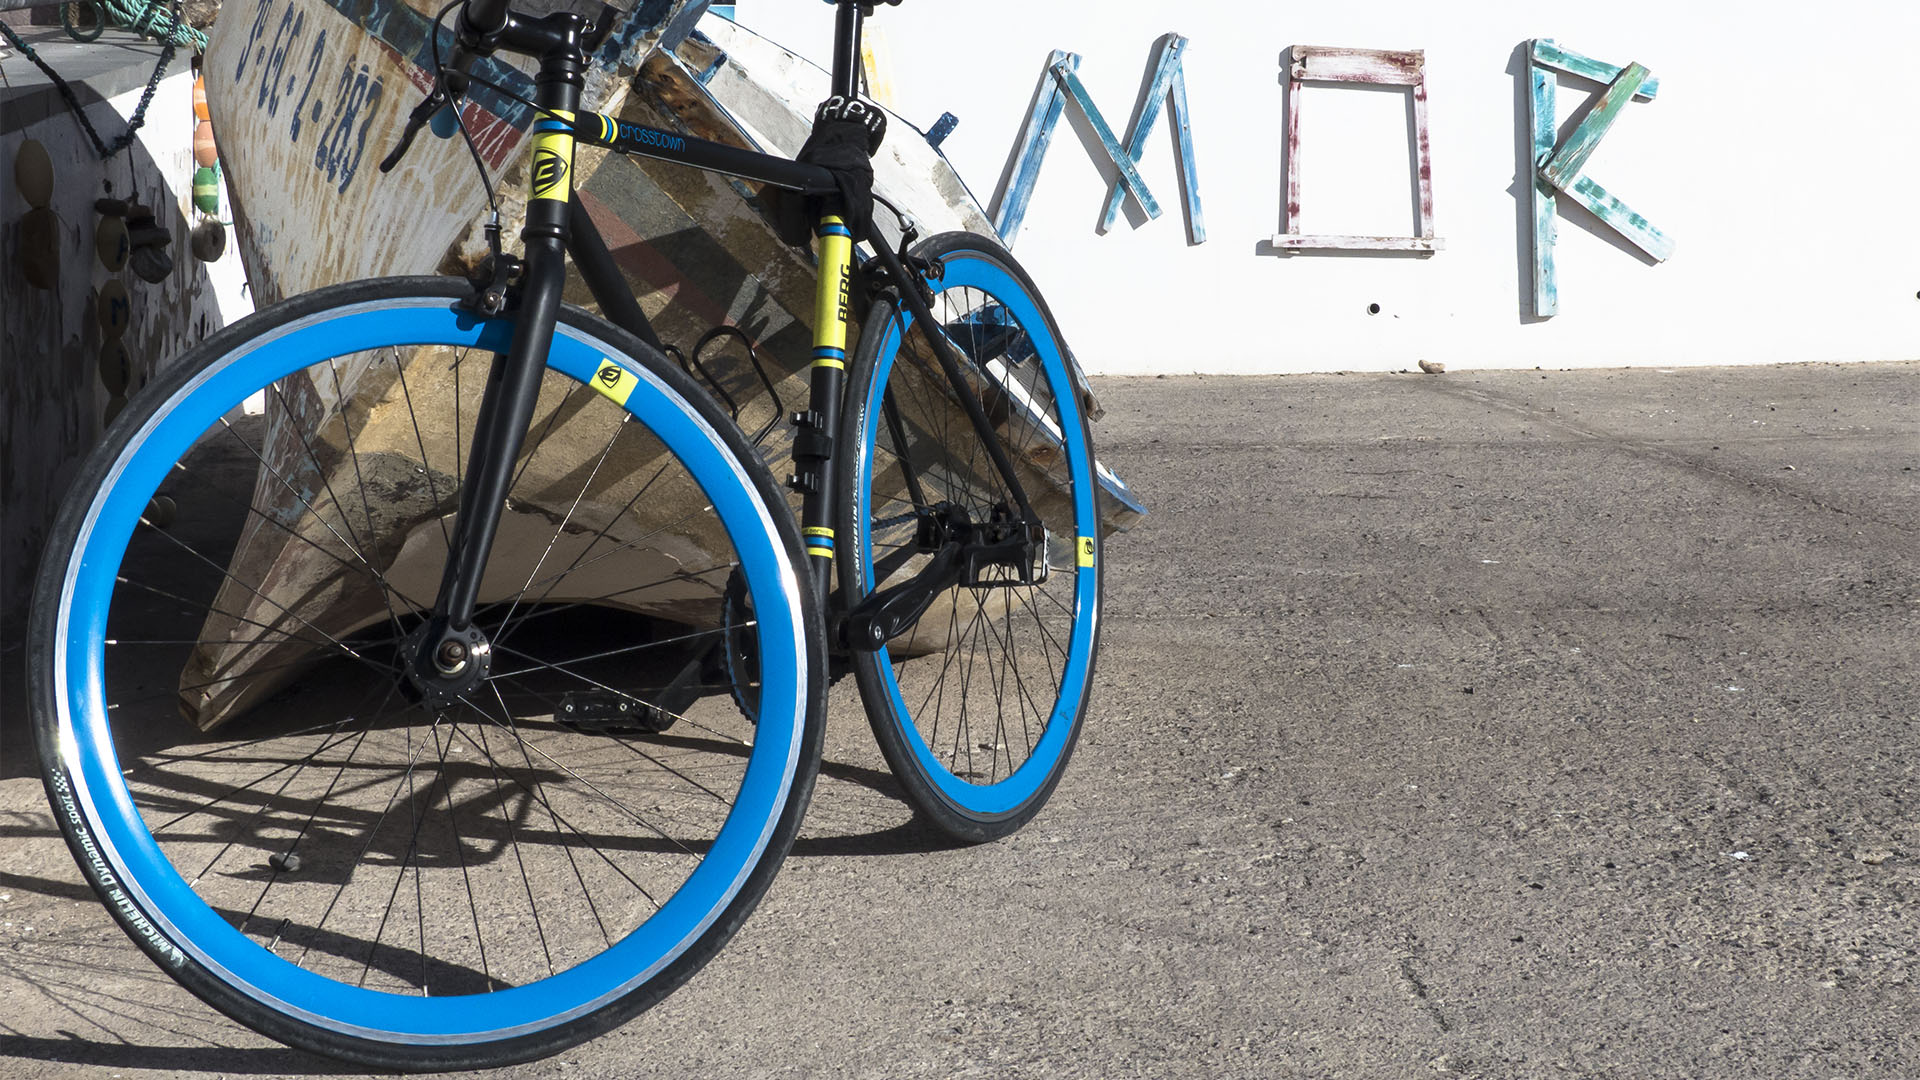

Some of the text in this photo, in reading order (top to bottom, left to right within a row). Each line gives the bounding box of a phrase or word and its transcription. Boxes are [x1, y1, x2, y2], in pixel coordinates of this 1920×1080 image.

[619, 123, 686, 152] crosstown
[837, 263, 850, 325] BERG
[61, 795, 172, 953] MICHELIN Dynamic sport
